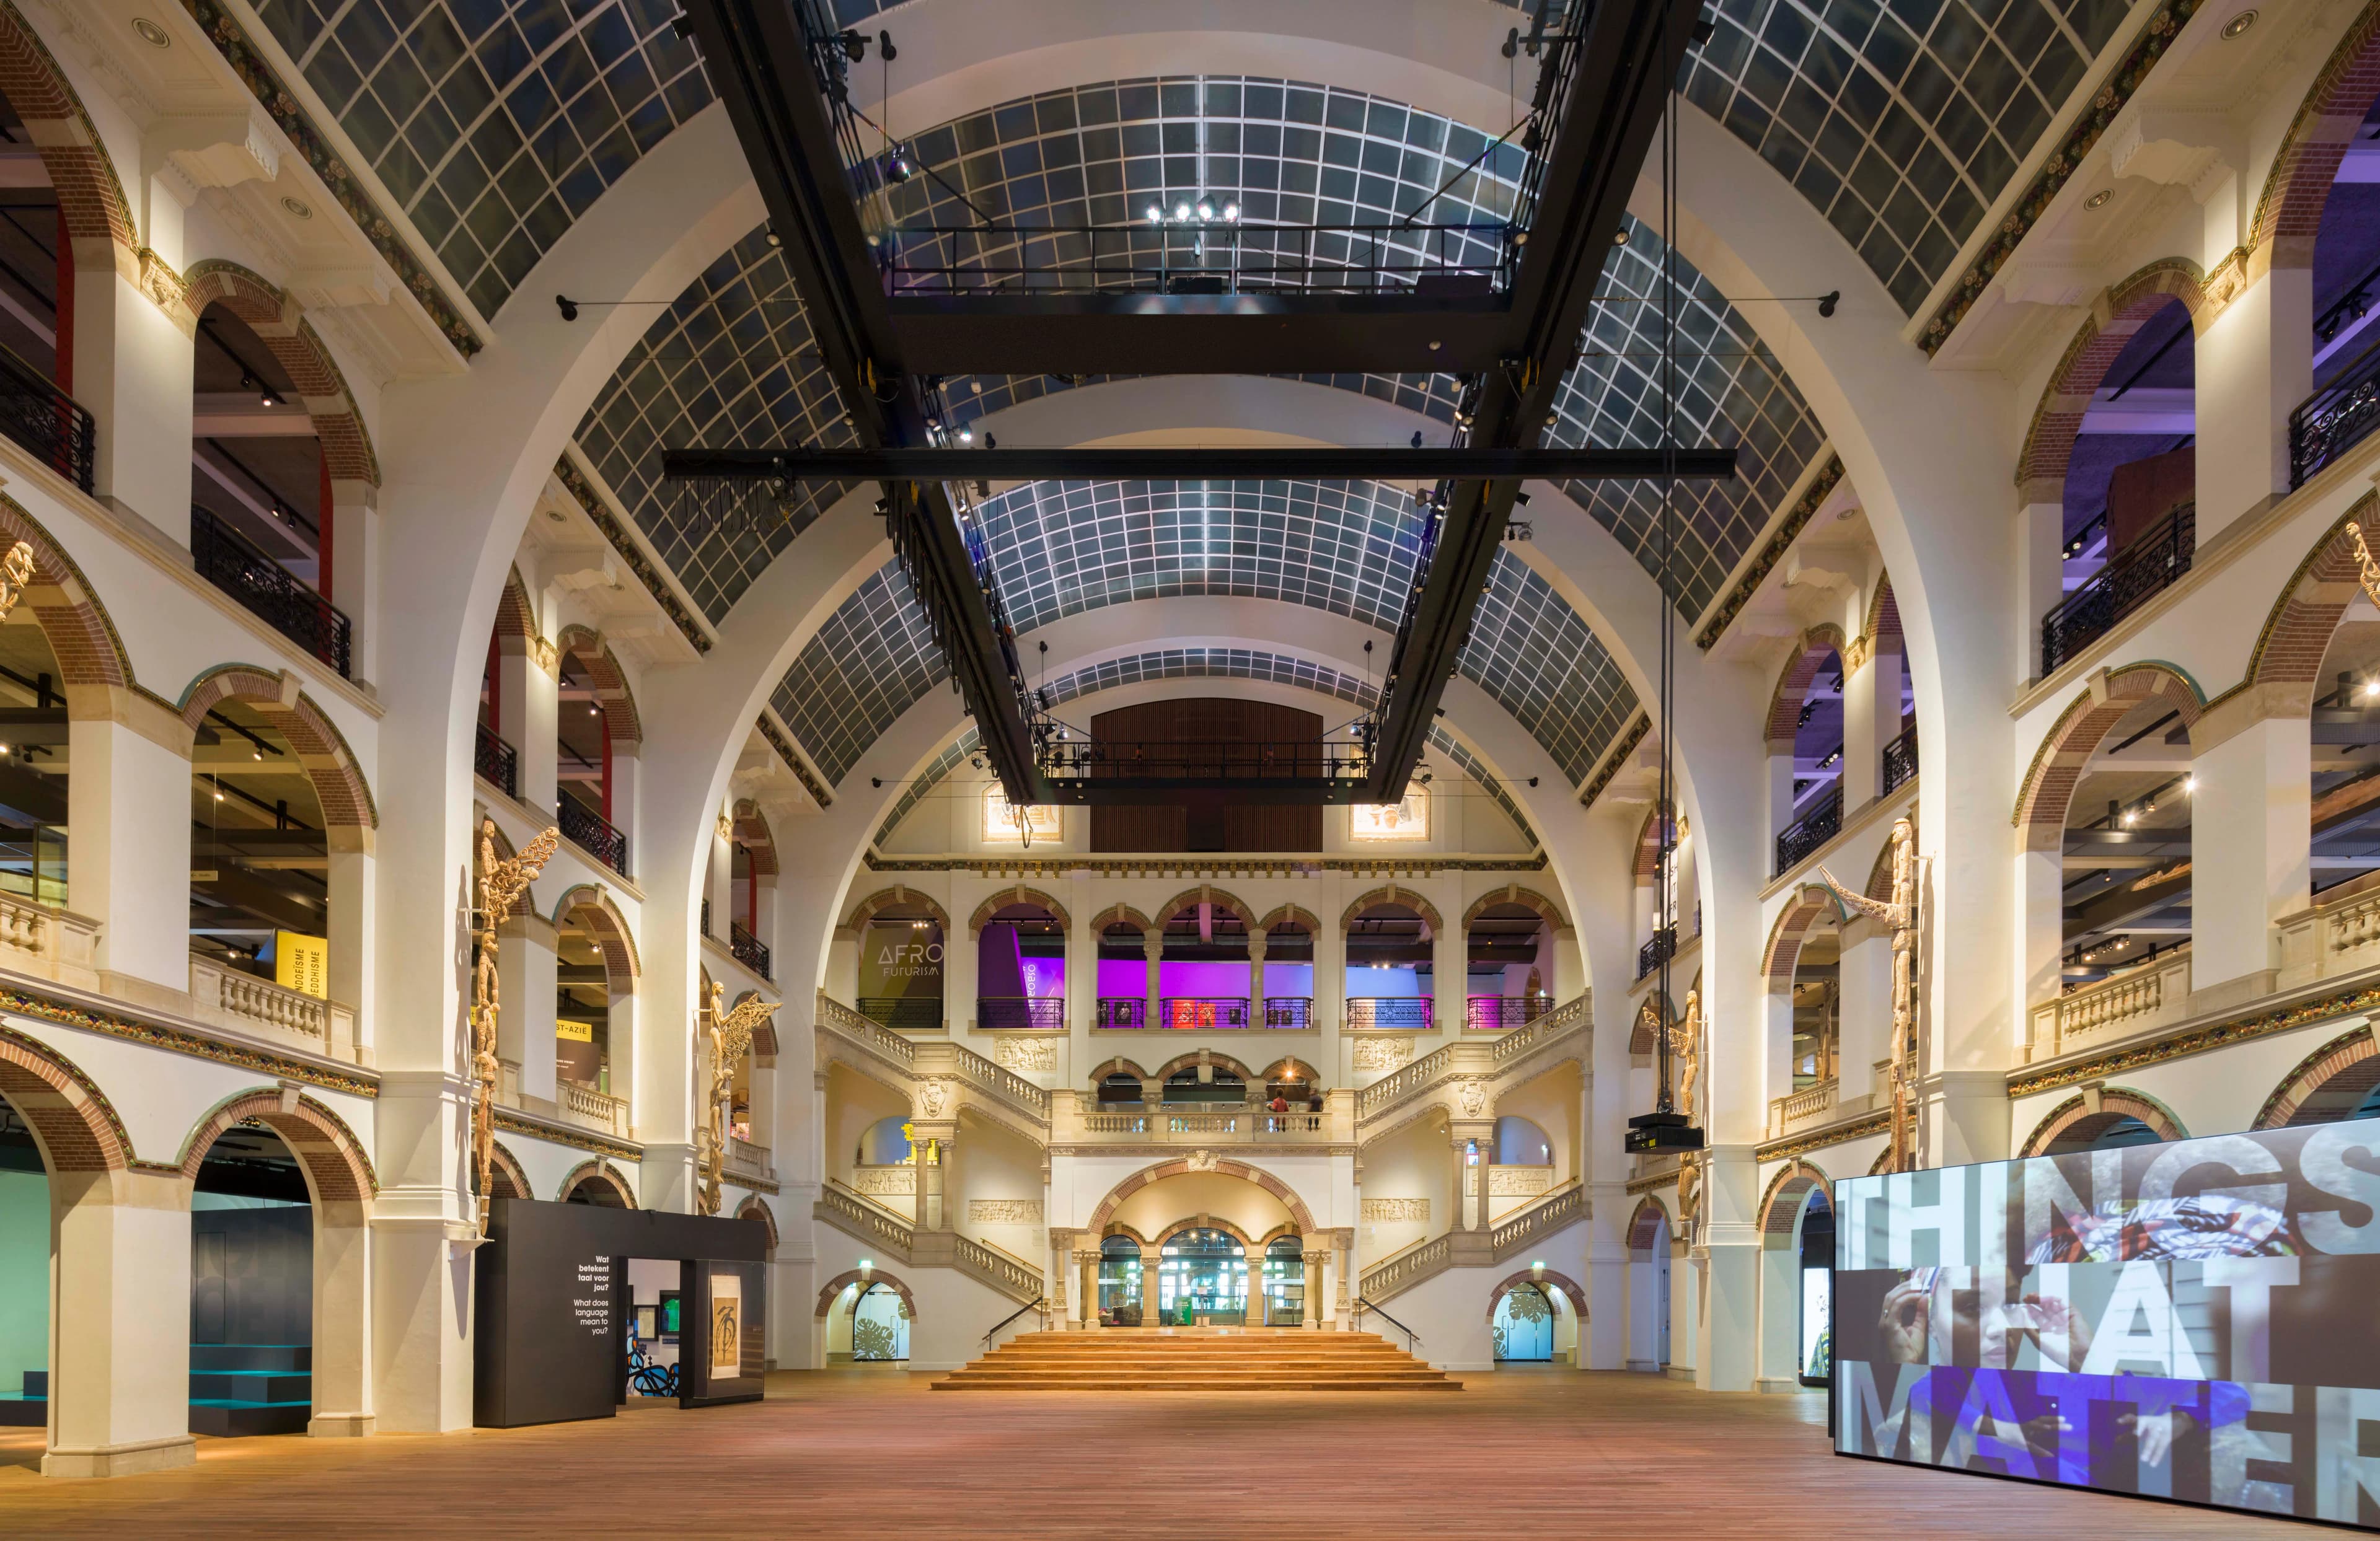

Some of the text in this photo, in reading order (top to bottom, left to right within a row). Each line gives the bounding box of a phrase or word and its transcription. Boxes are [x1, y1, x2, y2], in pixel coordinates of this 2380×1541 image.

[878, 943, 944, 964] AFRO
[883, 967, 939, 977] FUTURISM
[1835, 1118, 2380, 1271] THINGS
[596, 1255, 609, 1263] Wat
[579, 1264, 609, 1272] betekent
[578, 1273, 593, 1281] taal
[593, 1283, 609, 1292] jou?
[575, 1309, 609, 1317] language
[1910, 1255, 2299, 1383] THAT
[592, 1327, 608, 1335] you?
